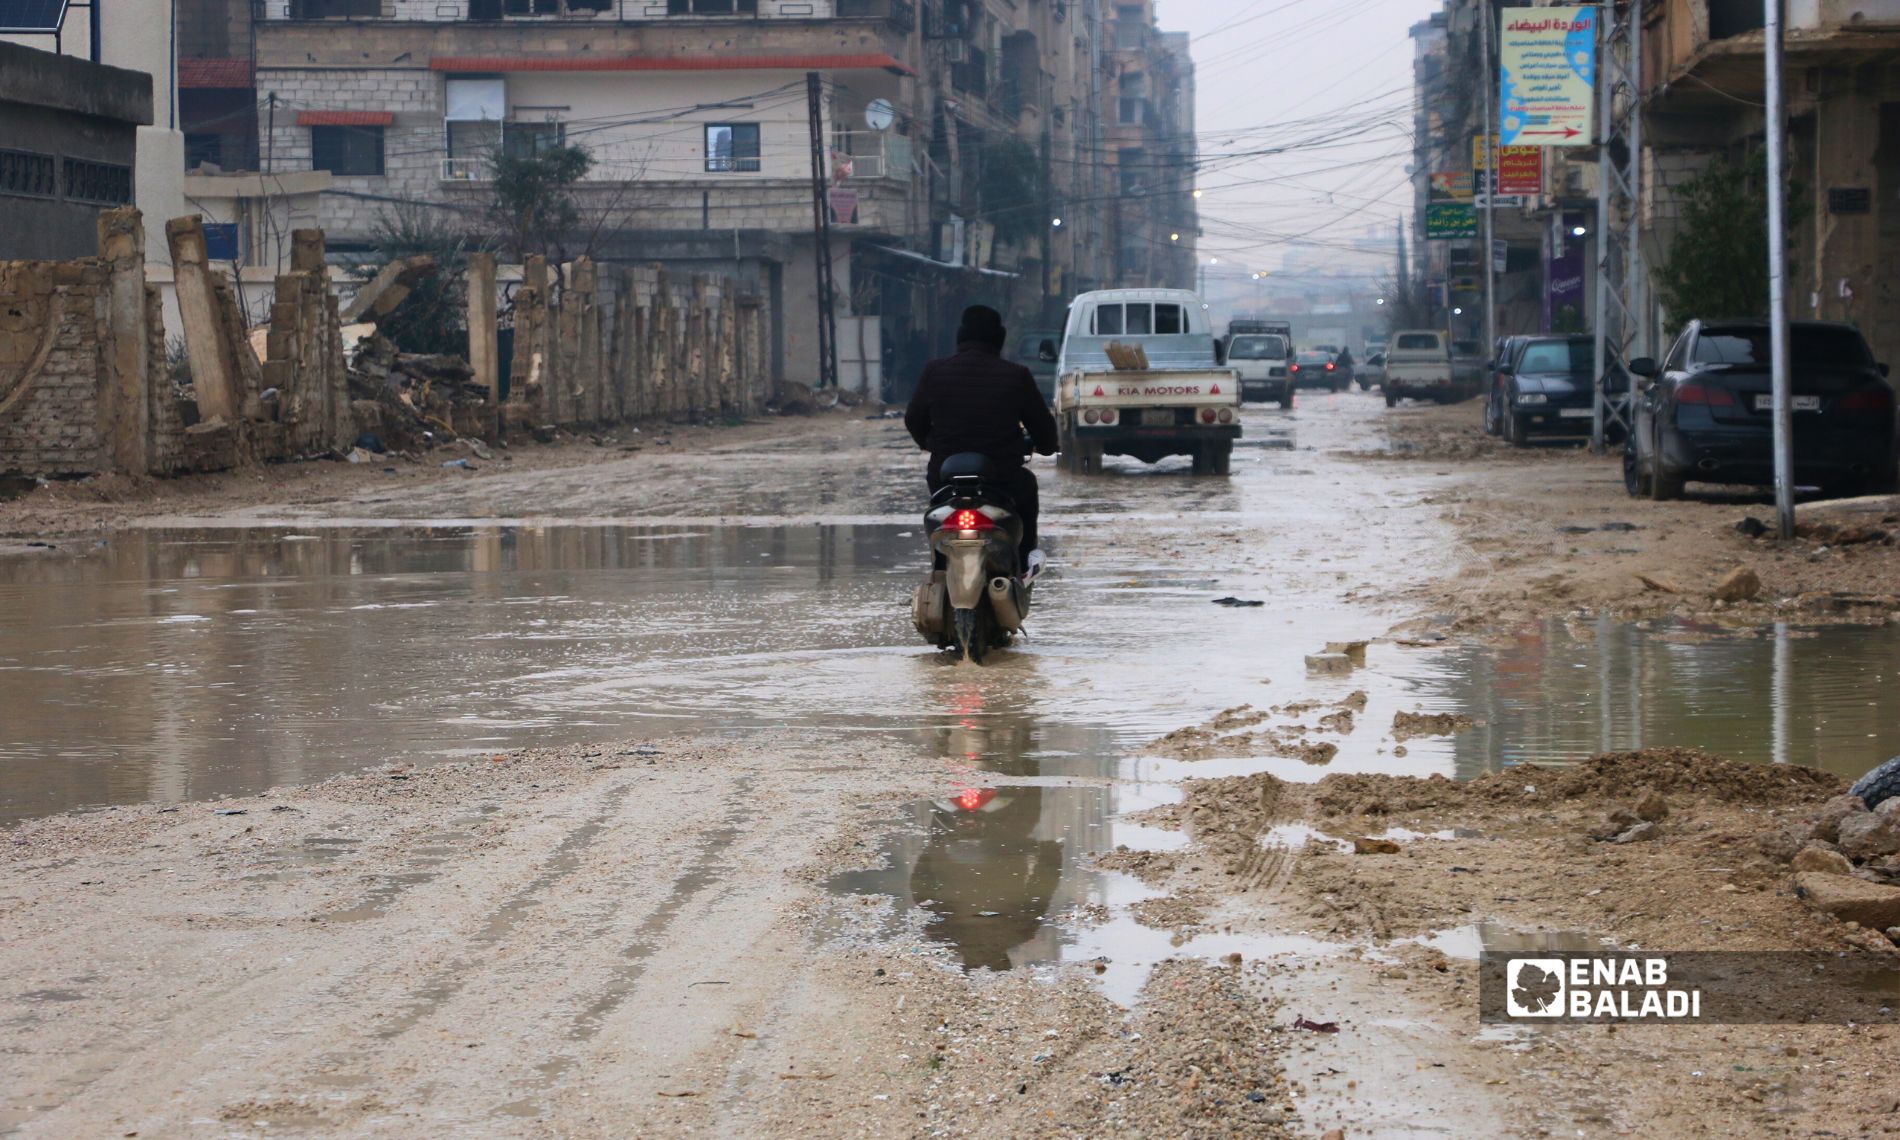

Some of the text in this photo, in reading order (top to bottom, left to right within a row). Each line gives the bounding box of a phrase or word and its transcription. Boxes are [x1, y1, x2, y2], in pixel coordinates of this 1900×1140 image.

[1507, 18, 1590, 33] الوردة البيضاء
[1118, 386, 1200, 396] KIA MOTORS
